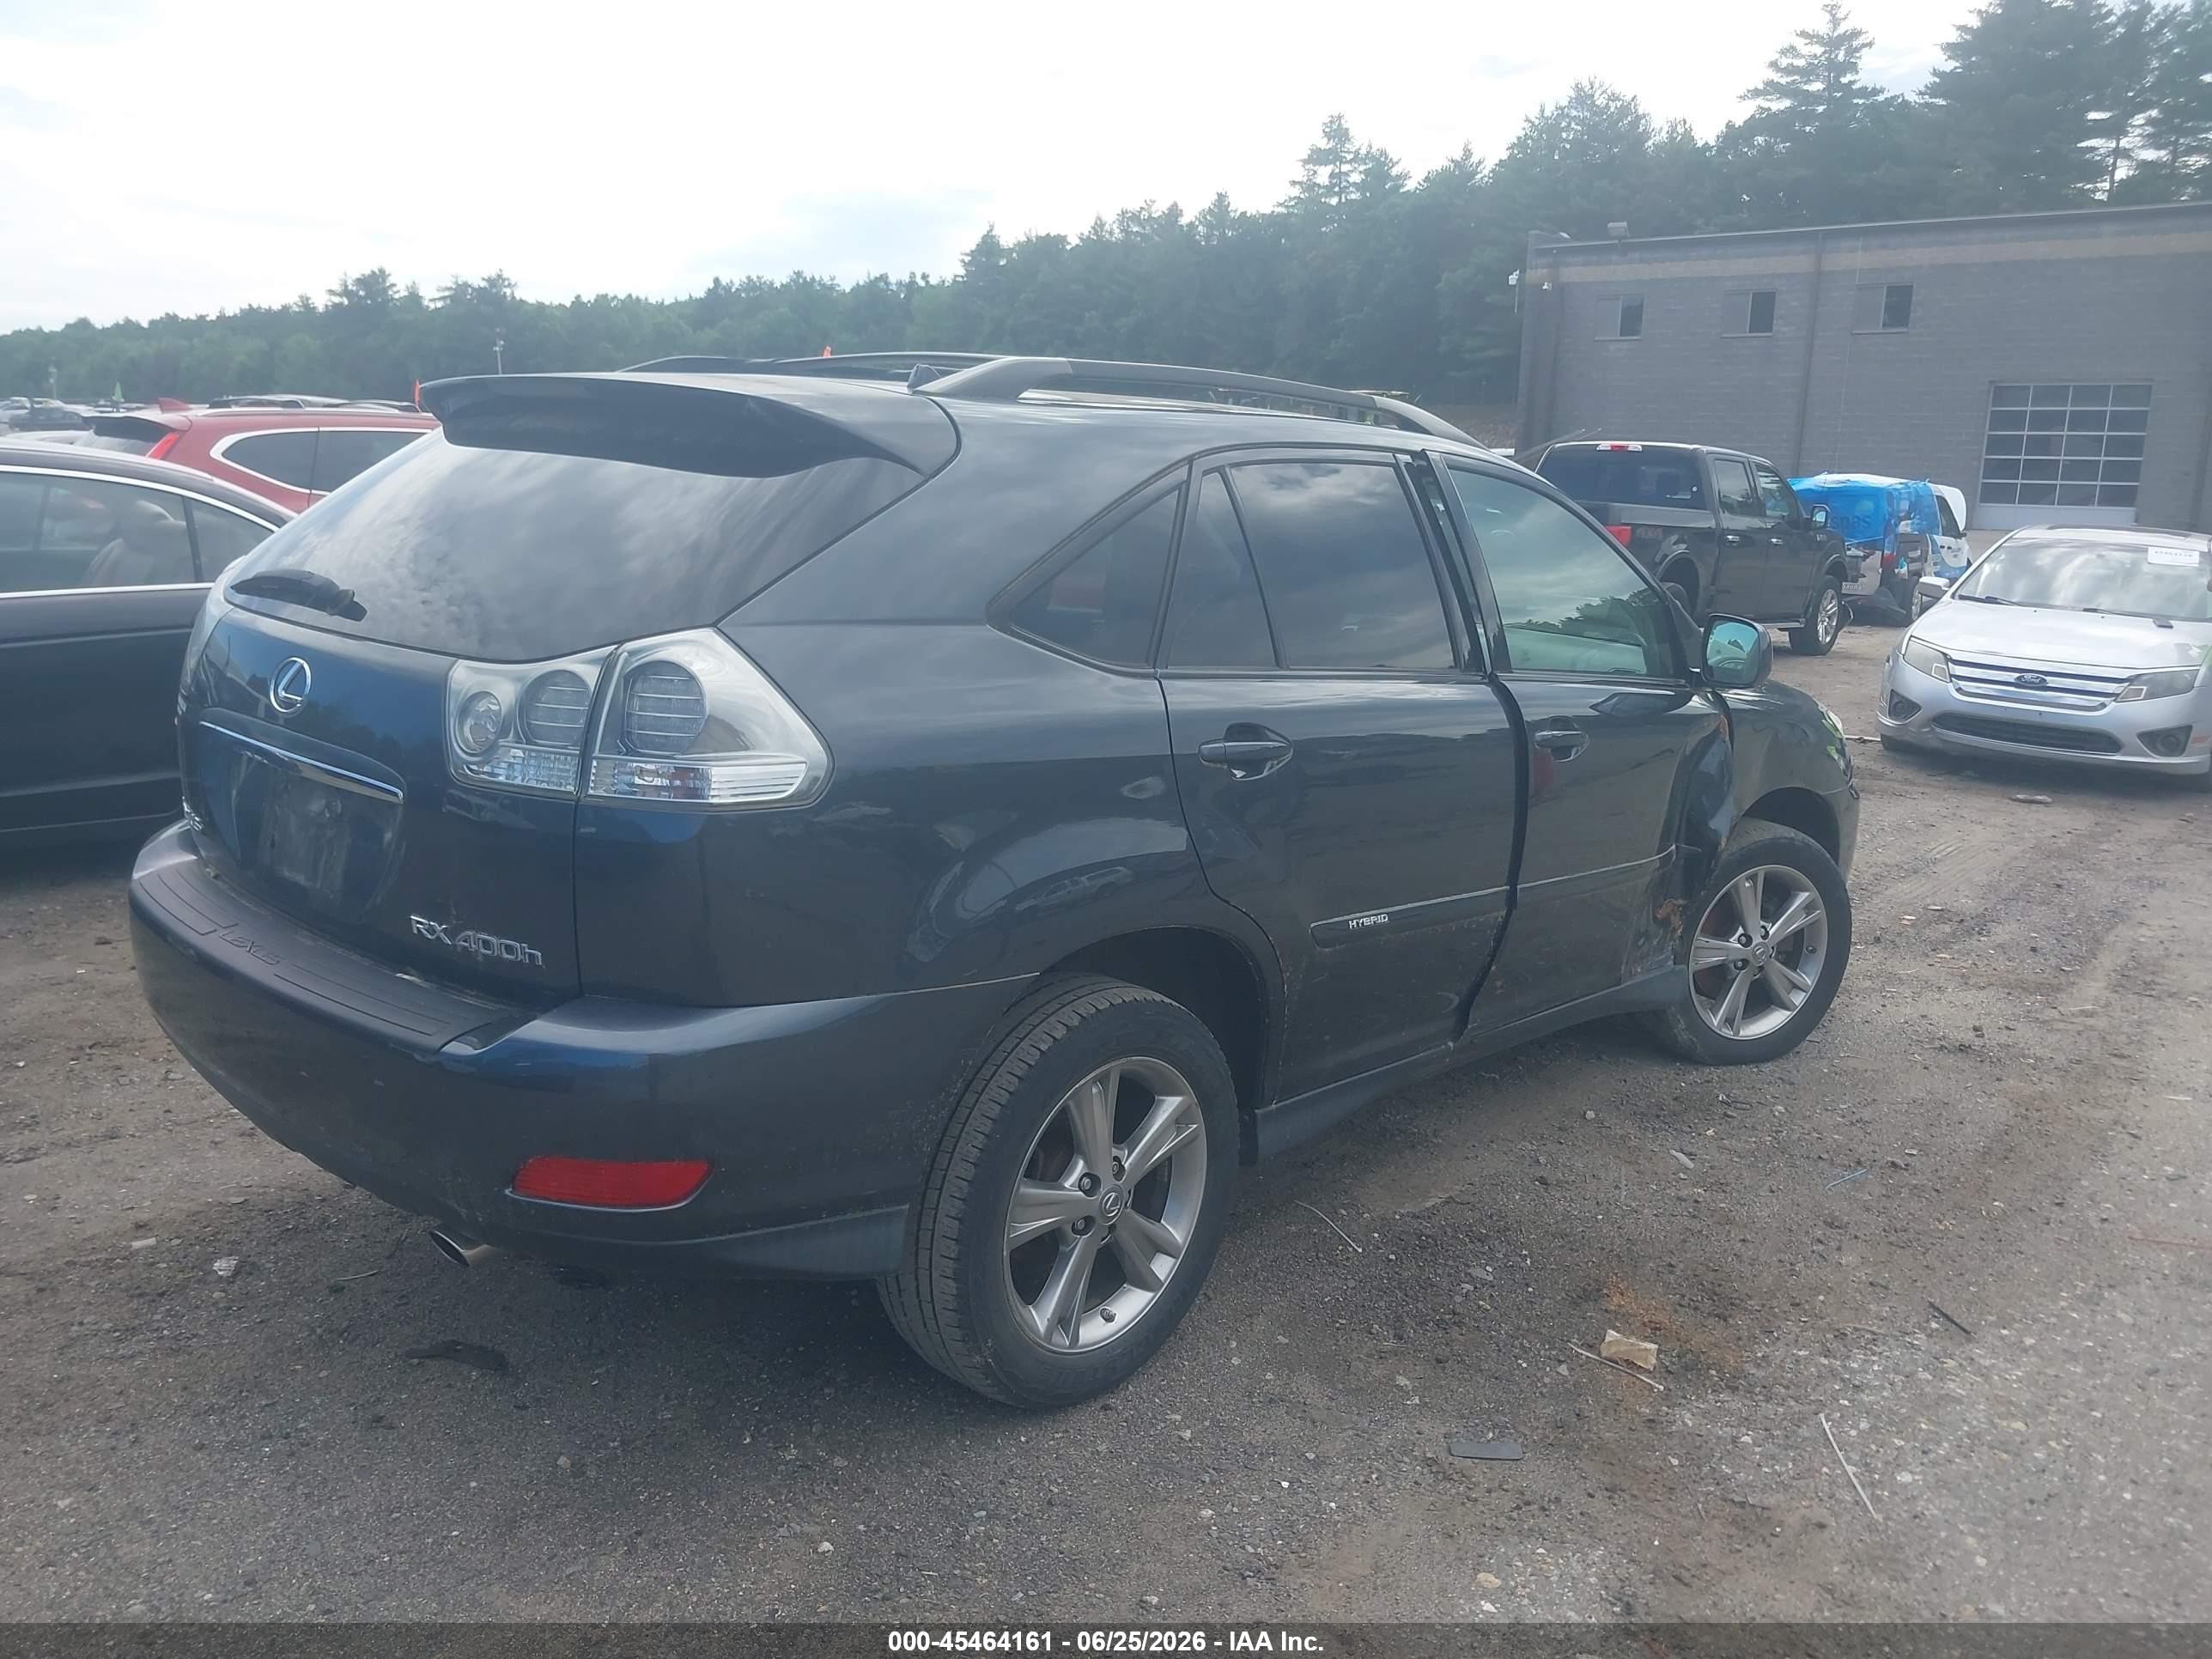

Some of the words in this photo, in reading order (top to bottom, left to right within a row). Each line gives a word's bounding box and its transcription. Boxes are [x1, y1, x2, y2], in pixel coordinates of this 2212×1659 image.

[1348, 914, 1389, 929] HYBRID
[410, 915, 452, 945] RX
[454, 930, 544, 966] 400h
